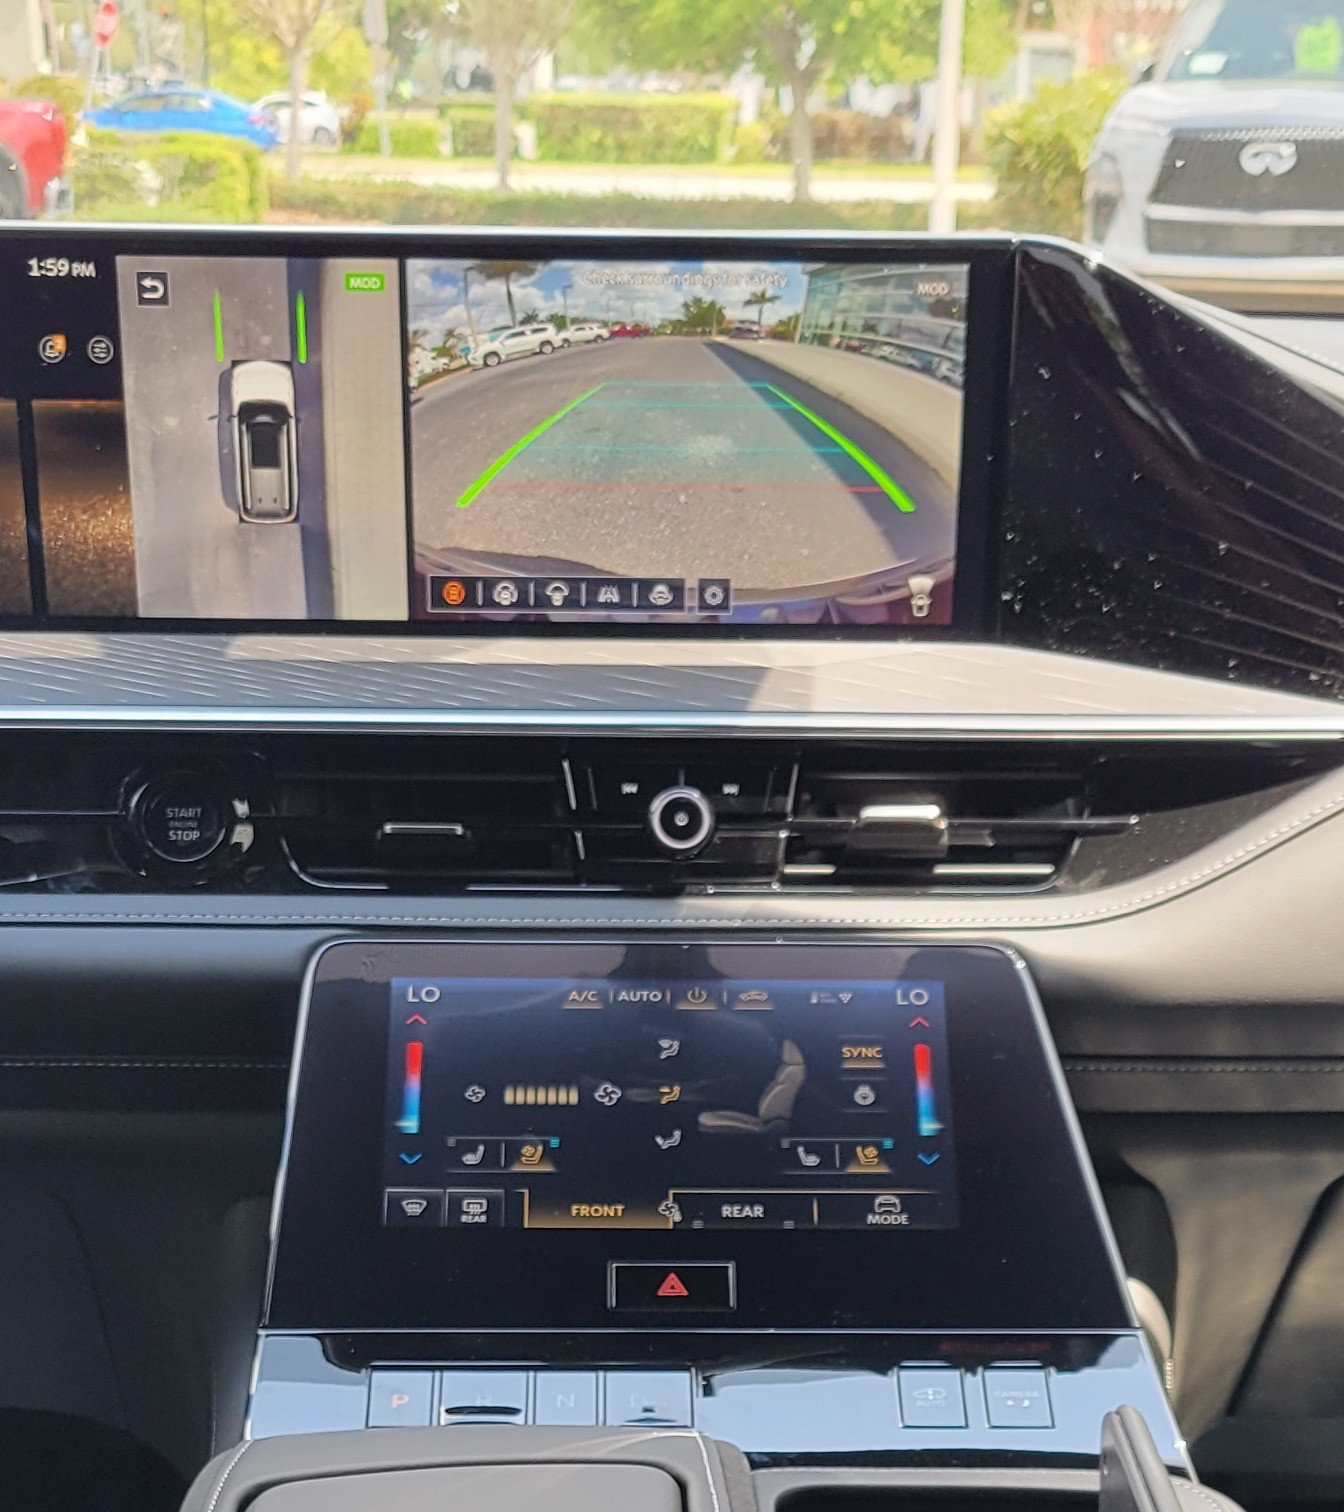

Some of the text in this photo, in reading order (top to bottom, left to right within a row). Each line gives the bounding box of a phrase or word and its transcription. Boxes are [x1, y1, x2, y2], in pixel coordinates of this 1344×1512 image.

[28, 257, 96, 278] 1:59 PM
[349, 277, 382, 290] MOD
[583, 269, 624, 286] Check
[627, 270, 722, 288] surroundings
[723, 269, 742, 286] for
[916, 282, 951, 296] MOD
[166, 807, 202, 818] START
[168, 830, 201, 841] STOP
[407, 986, 441, 1003] LO
[567, 990, 598, 1002] A/C
[618, 991, 662, 1003] AUTO
[896, 989, 929, 1006] LO
[841, 1046, 883, 1058] SYNC
[570, 1204, 625, 1218] FRONT
[721, 1204, 765, 1218] REAR
[460, 1214, 487, 1224] REAR
[867, 1214, 909, 1225] MODE
[391, 1393, 409, 1408] P
[557, 1394, 574, 1408] N
[995, 1390, 1039, 1399] CAMERA
[915, 1400, 946, 1408] AUTO
